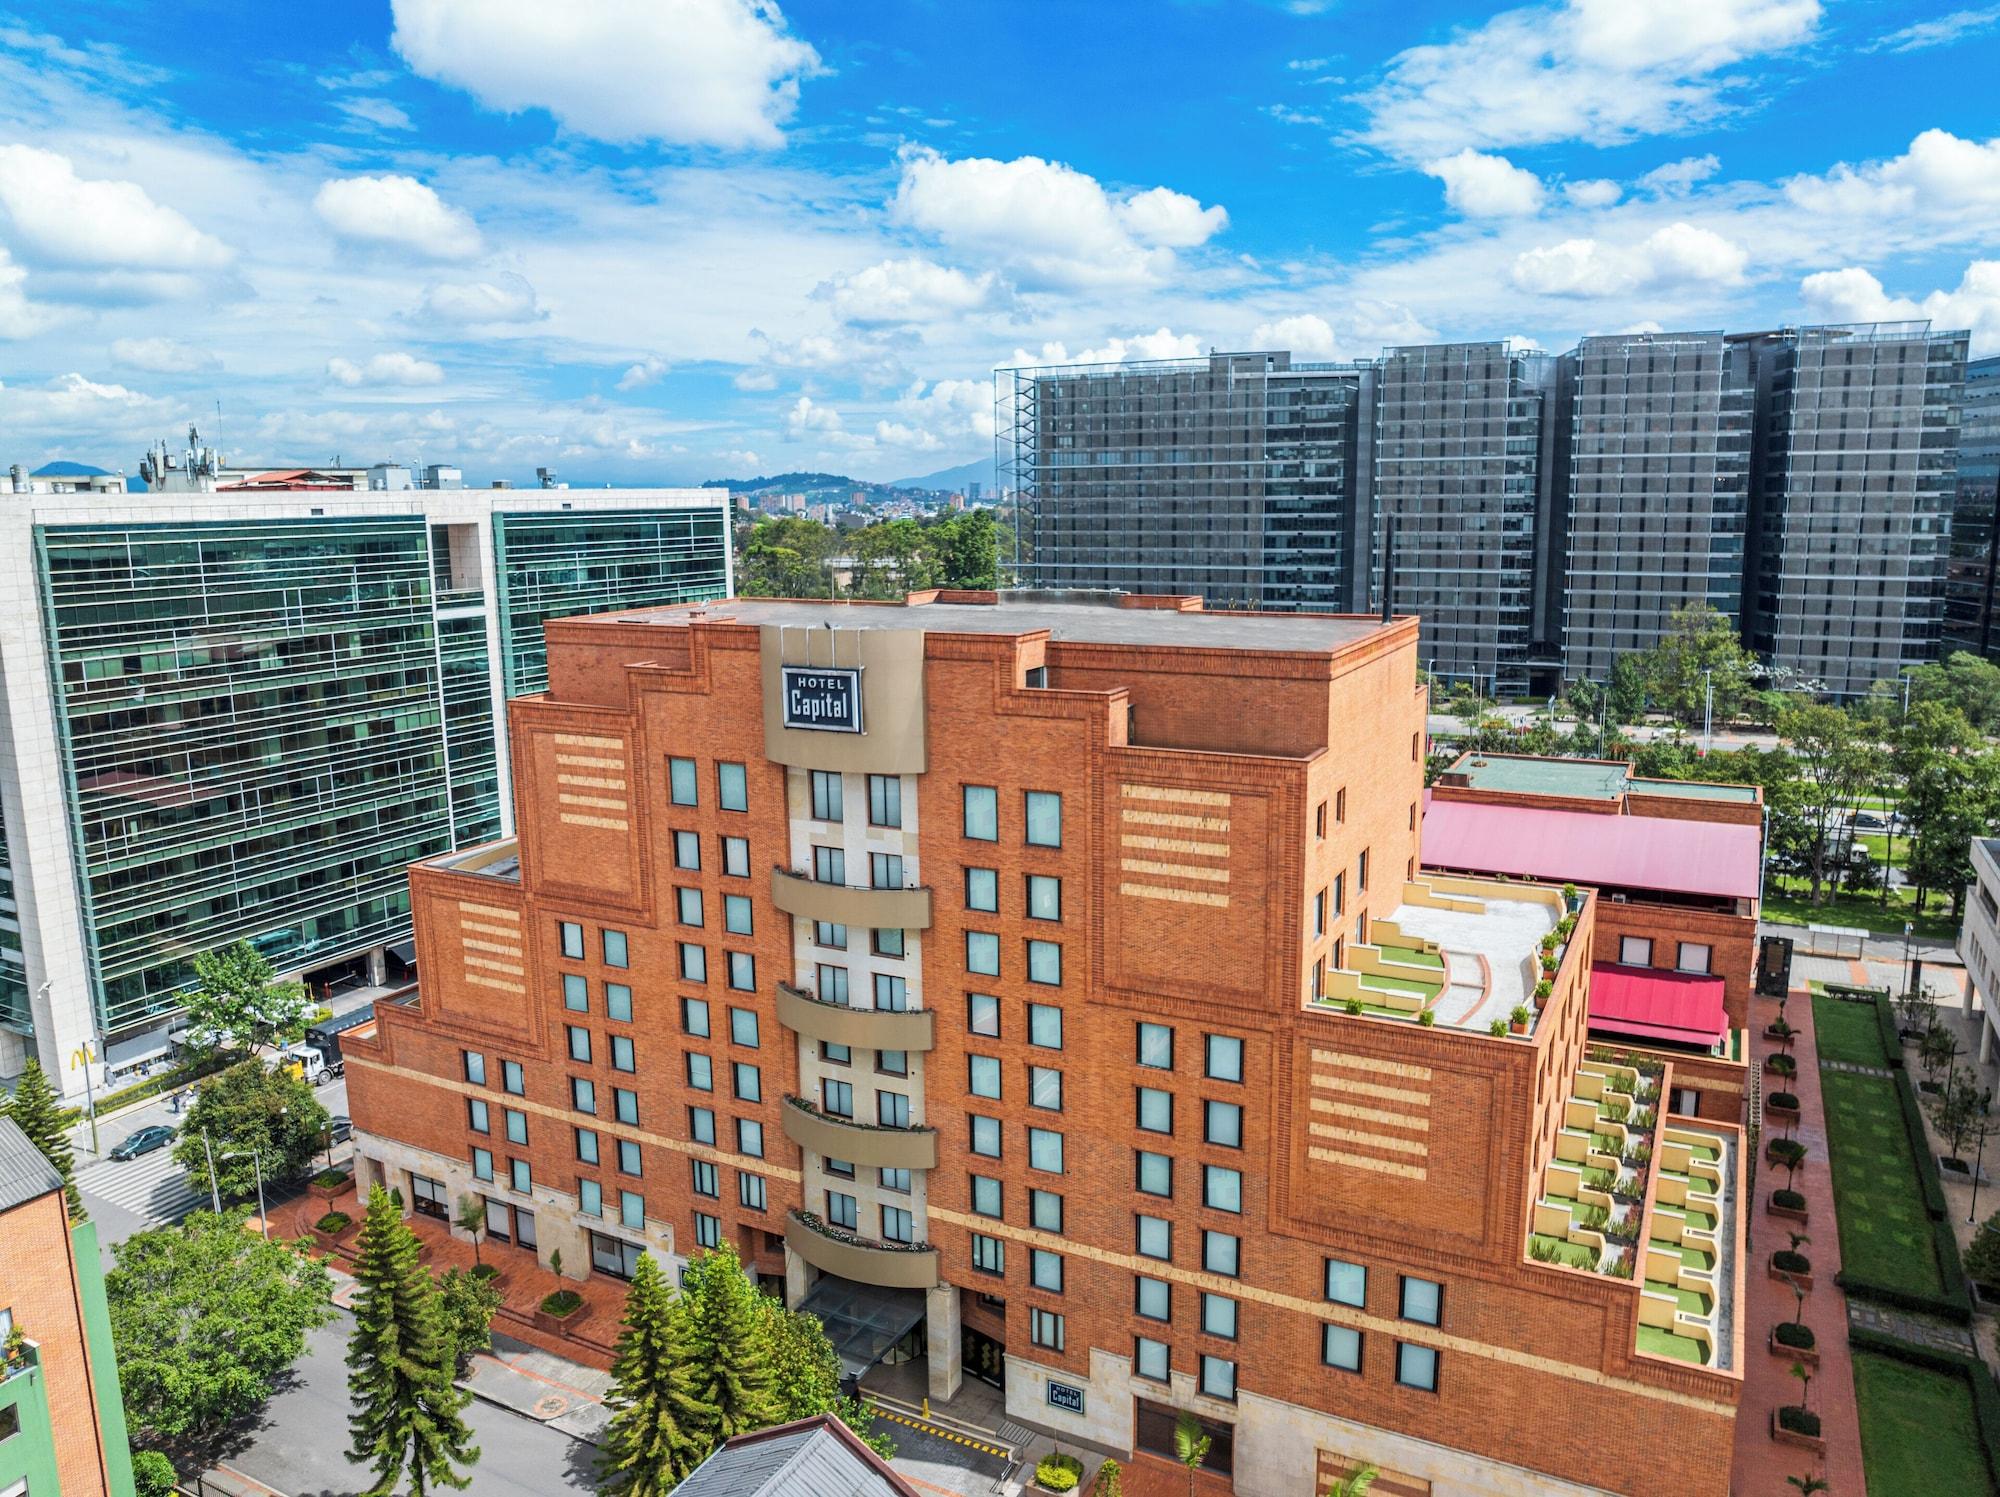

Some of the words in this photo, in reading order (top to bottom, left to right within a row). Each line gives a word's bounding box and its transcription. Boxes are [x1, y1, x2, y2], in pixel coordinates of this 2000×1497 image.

[798, 677, 844, 690] HOTEL
[791, 689, 847, 721] Capital
[1052, 1390, 1080, 1408] Capital
[1055, 1386, 1079, 1397] HOTEL
